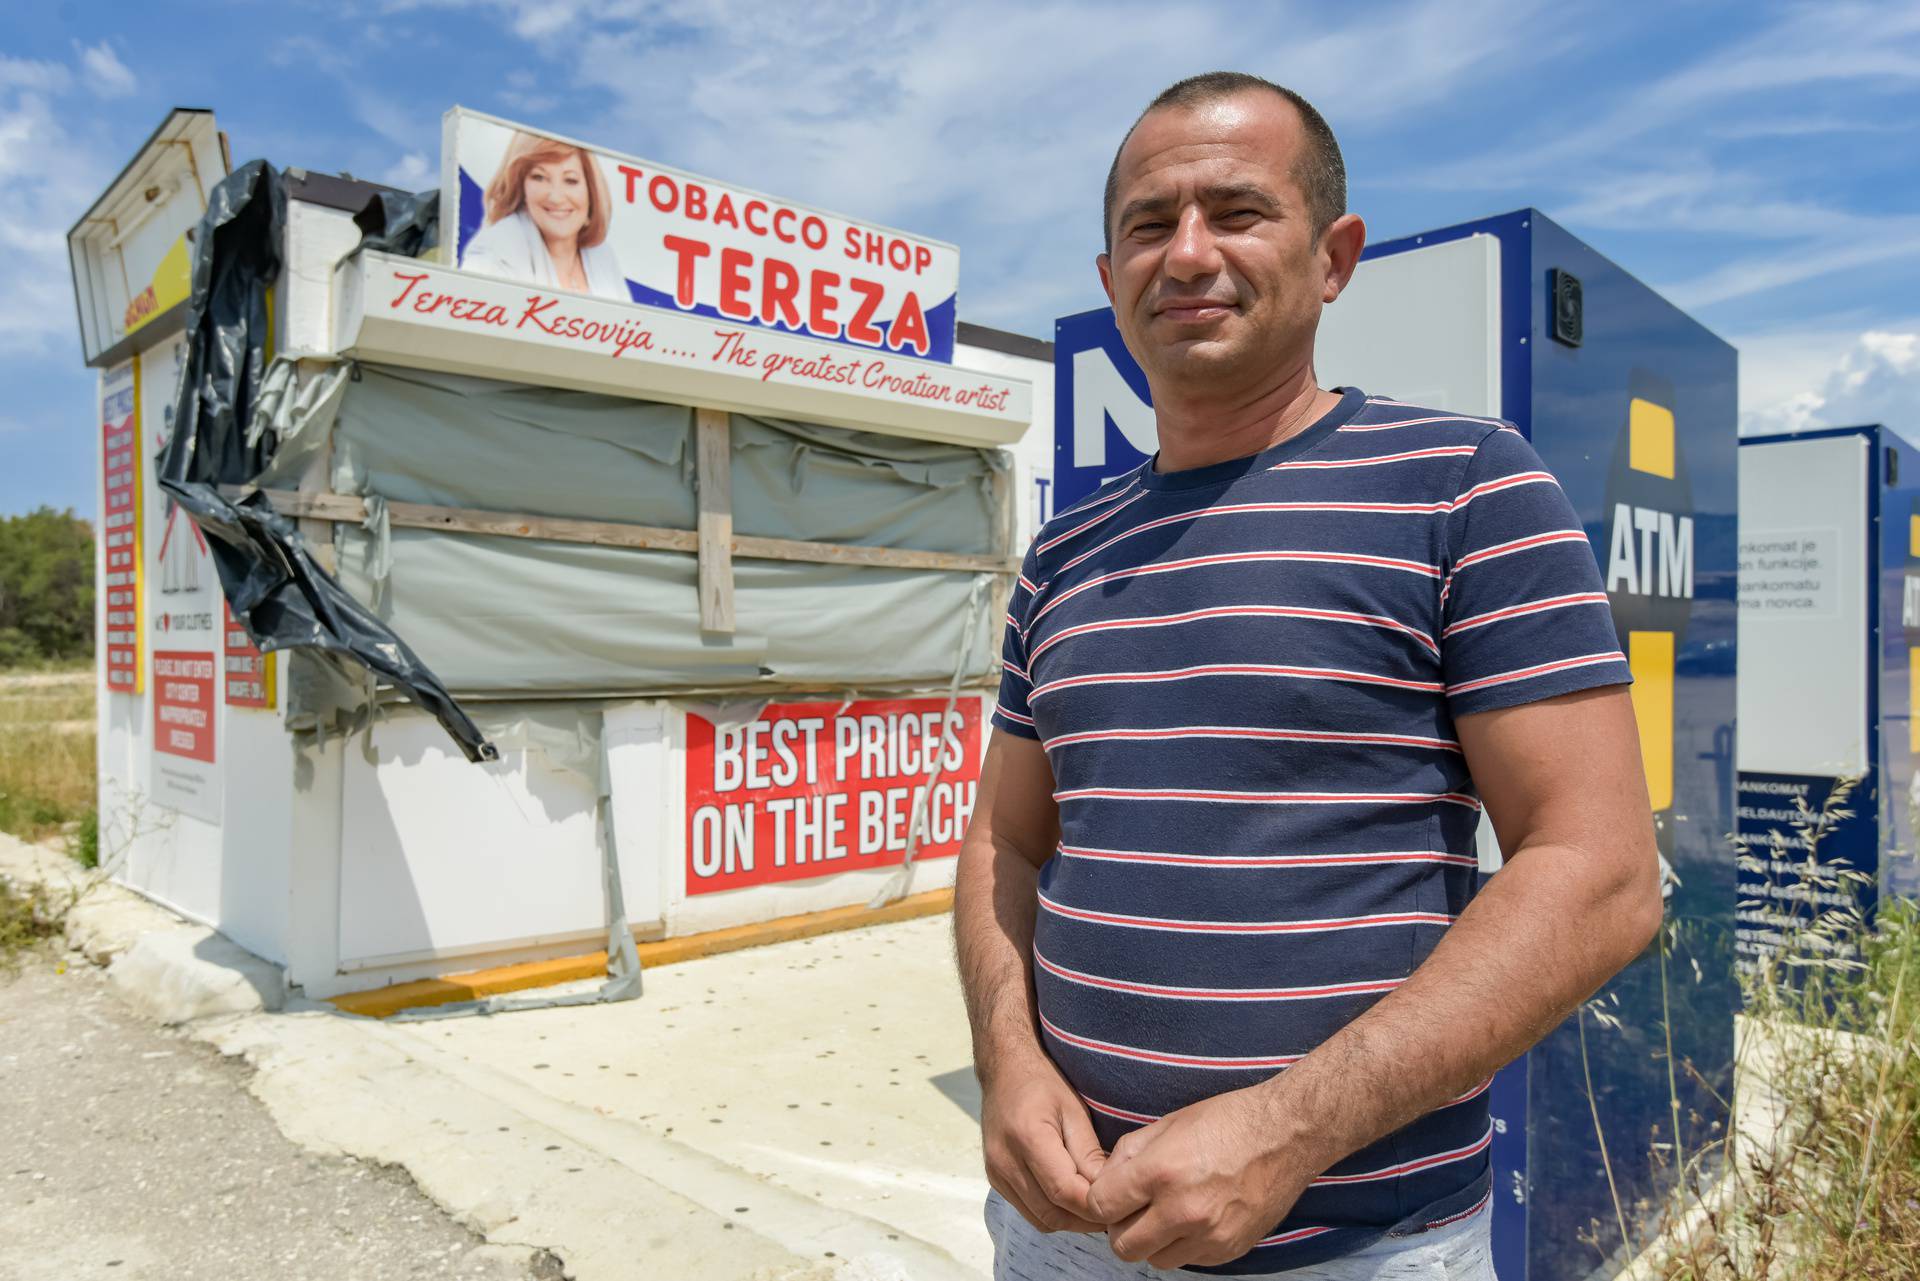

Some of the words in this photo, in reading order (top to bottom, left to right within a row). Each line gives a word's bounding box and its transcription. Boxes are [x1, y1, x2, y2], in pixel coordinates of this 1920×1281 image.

[618, 165, 828, 250] TOBACCO
[844, 228, 932, 275] SHOP
[391, 271, 508, 325] Tereza
[516, 296, 654, 358] Kesovija
[712, 330, 756, 366] The
[763, 352, 859, 382] greatest
[863, 360, 951, 403] Croatian
[955, 384, 1010, 411] artist
[663, 234, 931, 356] TEREZA
[1607, 503, 1694, 599] ATM
[714, 718, 824, 793] BEST
[835, 710, 965, 782] PRICES
[692, 802, 755, 878] ON
[766, 793, 849, 868] THE
[859, 780, 977, 855] BEACH
